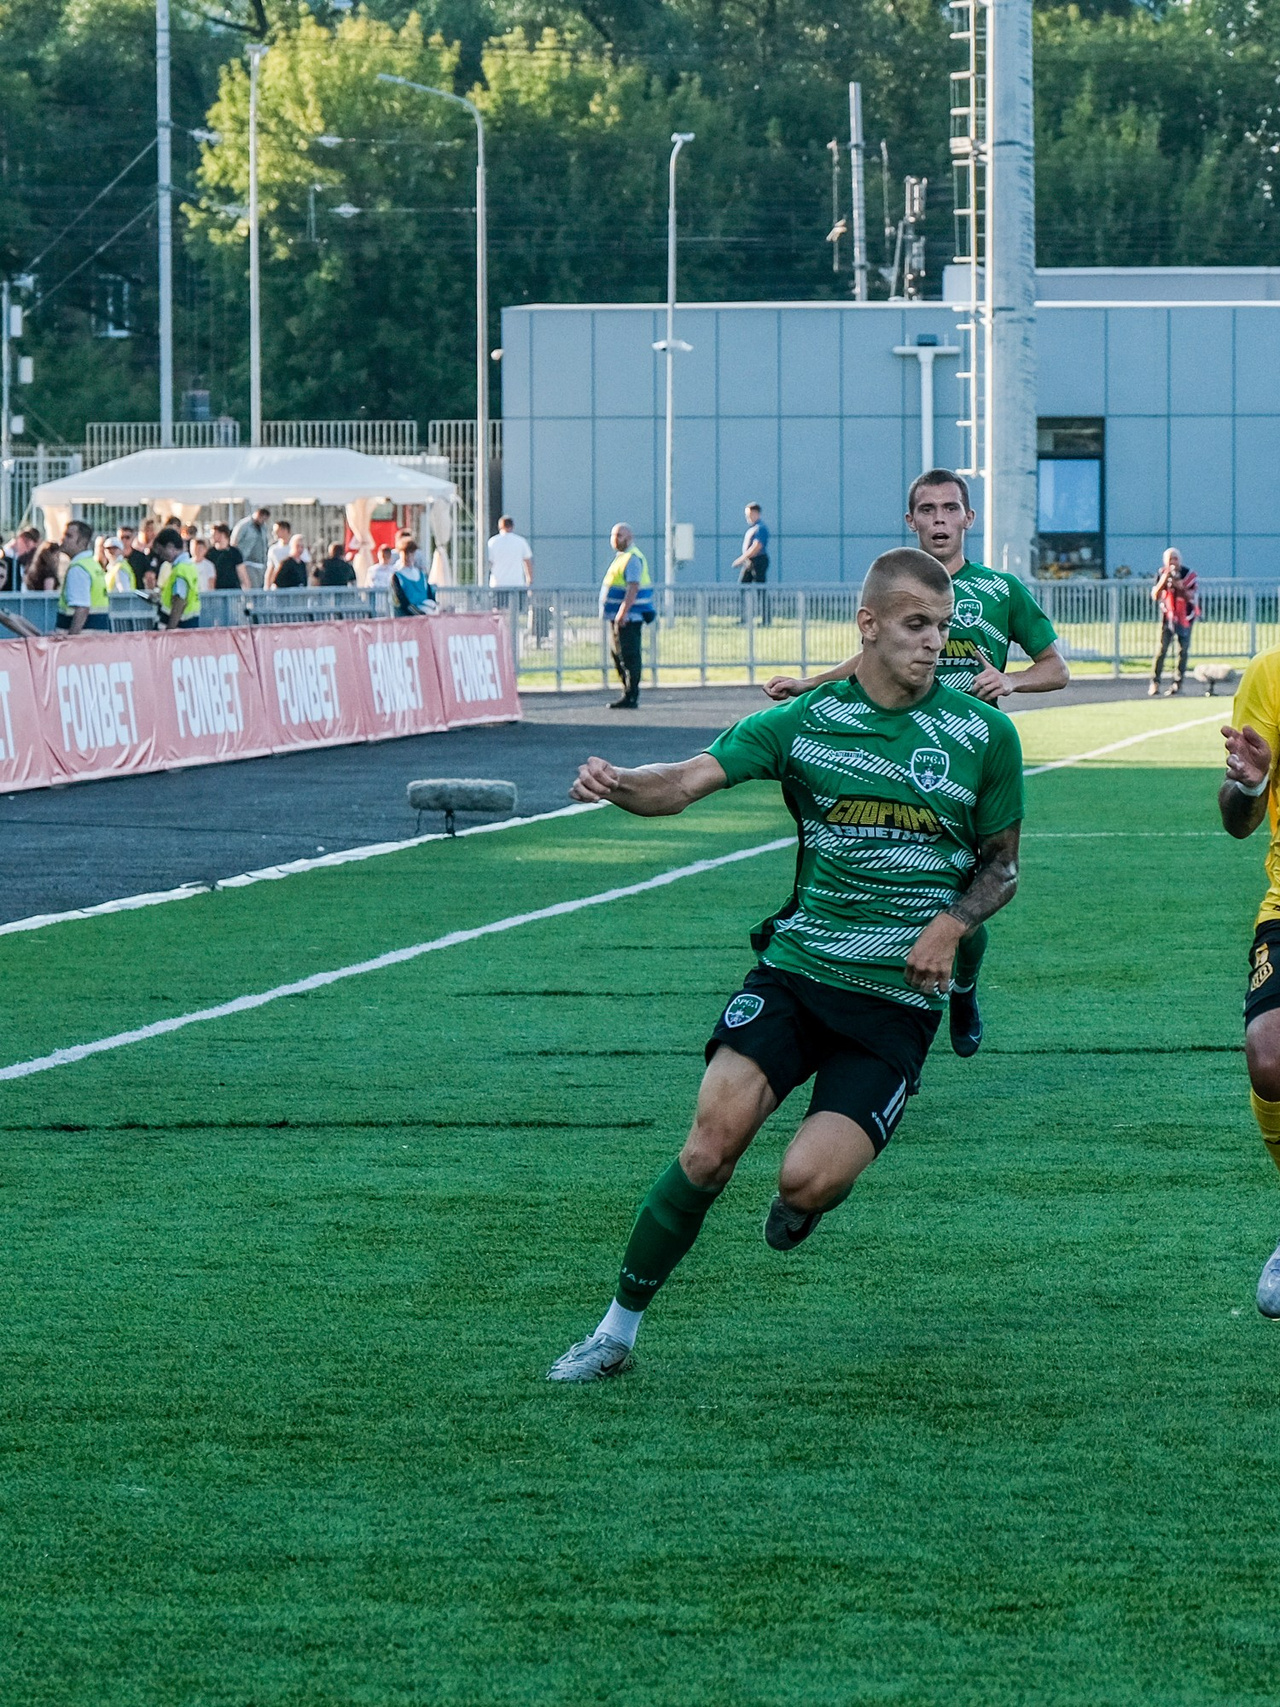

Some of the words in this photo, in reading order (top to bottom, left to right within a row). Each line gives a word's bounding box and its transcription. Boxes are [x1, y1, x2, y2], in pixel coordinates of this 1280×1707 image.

[172, 653, 244, 738] FONBET
[273, 646, 340, 725] FONBET
[367, 639, 424, 714] FONBET
[448, 634, 503, 703] FONBET
[57, 661, 138, 752] FONBET
[826, 800, 943, 833] СПОРИМ!
[621, 1267, 658, 1286] JAKO
